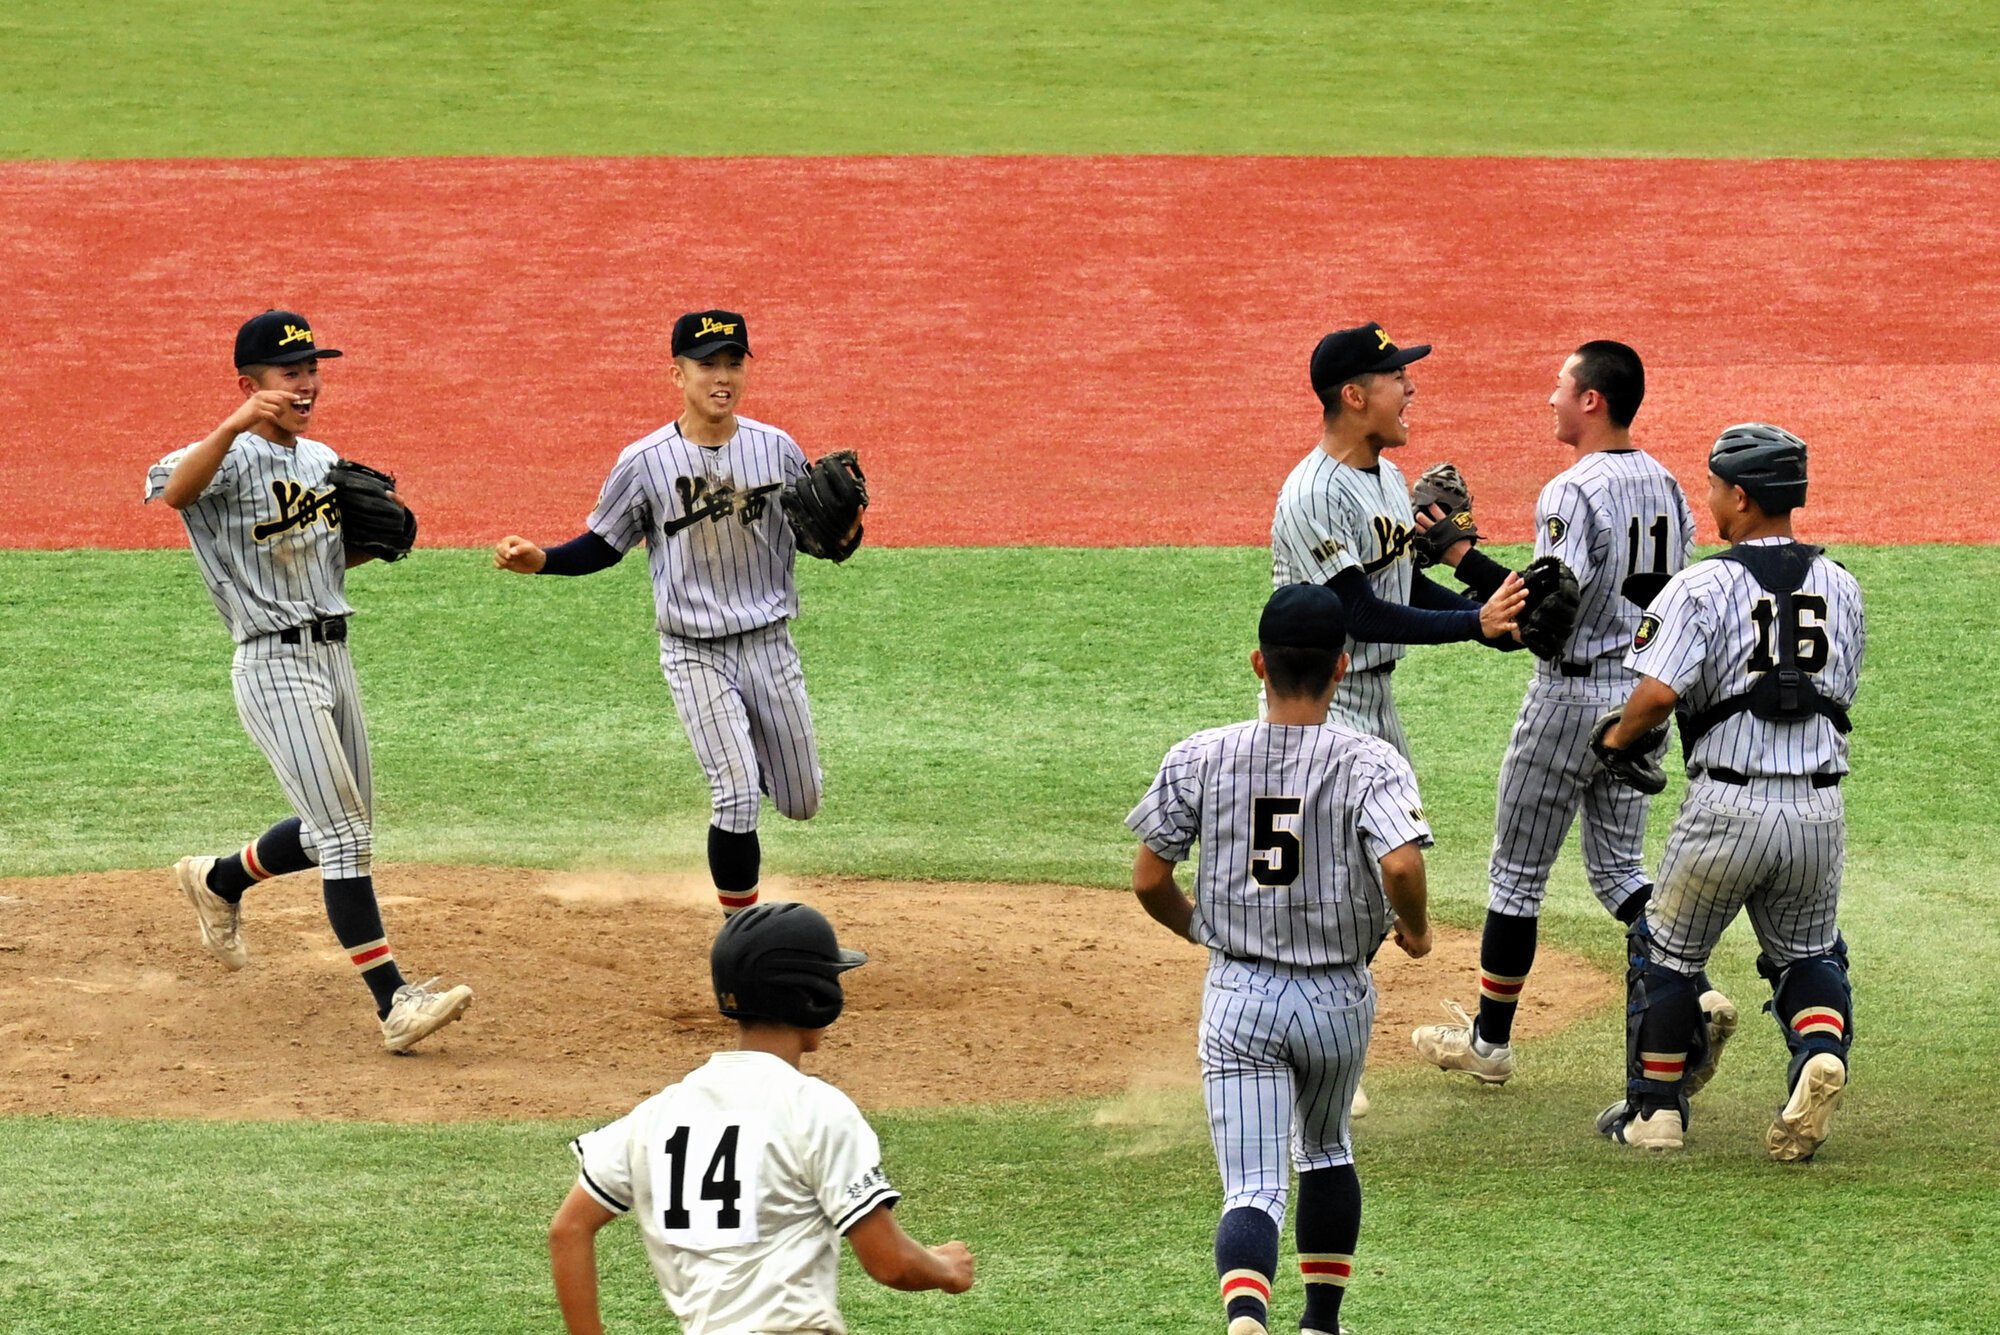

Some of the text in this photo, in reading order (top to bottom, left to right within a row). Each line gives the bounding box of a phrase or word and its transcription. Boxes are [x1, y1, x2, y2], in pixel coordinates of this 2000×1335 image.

[1627, 514, 1669, 575] 11
[1748, 592, 1830, 677] 16
[1251, 796, 1302, 888] 5
[664, 1124, 741, 1230] 14
